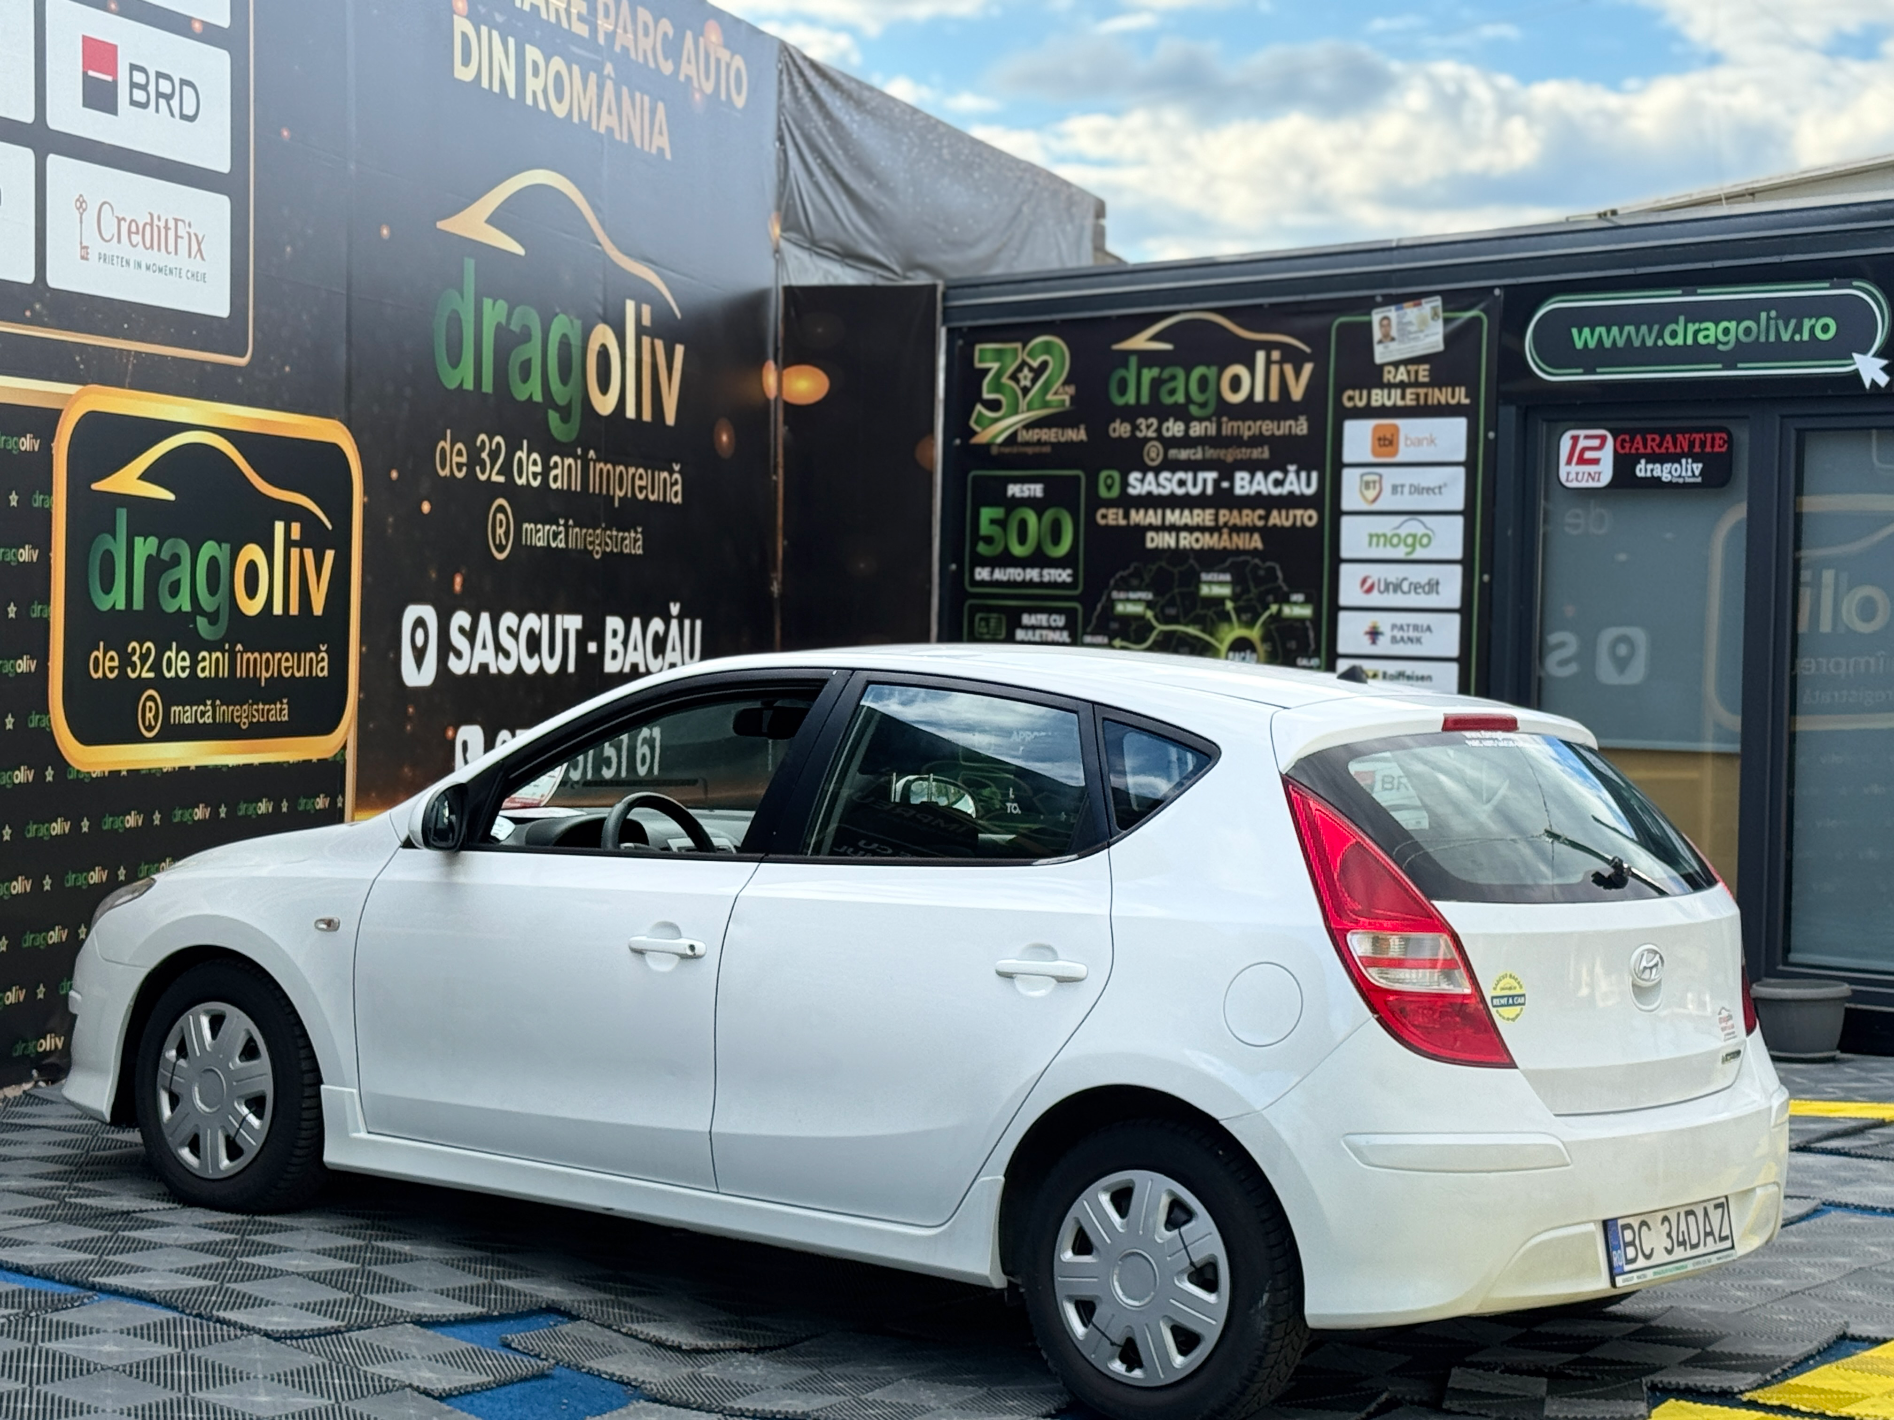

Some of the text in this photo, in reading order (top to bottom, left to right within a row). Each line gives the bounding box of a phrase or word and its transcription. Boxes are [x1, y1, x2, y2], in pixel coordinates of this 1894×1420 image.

[597, 0, 674, 76] PARC
[678, 29, 748, 110] AUTO
[128, 62, 201, 124] BRD
[454, 14, 672, 161] DIN ROMÂNIA
[96, 200, 206, 262] CreditFix
[98, 252, 207, 284] PRIETEN IN MOMENTE CHEIE
[1571, 309, 1838, 352] www.dragoliv.ro
[433, 256, 685, 443] dragoliv
[969, 334, 1070, 433] 32
[1108, 350, 1315, 417] dragoliv
[1382, 364, 1431, 384] RATE
[1342, 386, 1471, 408] CU BULETINUL
[1108, 415, 1308, 441] de 32 de ani împreună
[1377, 433, 1438, 448] tbi bank
[1565, 434, 1608, 466] 12
[1615, 432, 1728, 454] GARANTIE
[435, 429, 683, 508] de 32 de ani împreună
[1126, 470, 1219, 496] SASCUT
[1233, 463, 1318, 496] BACĂU
[1565, 471, 1603, 483] LUNI
[1635, 458, 1703, 482] dragoliv
[1007, 483, 1044, 498] PESTE
[1391, 484, 1406, 496] BT
[1095, 508, 1318, 527] CEL MAI MARE PARC AUTO
[522, 518, 566, 549] marcă
[568, 519, 643, 560] înregistrată
[976, 506, 1074, 558] 500
[1145, 528, 1263, 550] DIN ROMÂNIA
[1367, 532, 1432, 557] mogo
[88, 507, 336, 641] dragoliv
[974, 567, 1073, 583] DE AUTO PE STOC
[1377, 576, 1440, 596] UniCredit
[1021, 613, 1066, 627] RATE CU
[1390, 623, 1433, 634] PATRIA
[447, 610, 583, 676] SASCUT
[604, 602, 702, 673] BACĂU
[1015, 628, 1071, 643] BULETINUL
[1390, 635, 1423, 646] BANK
[88, 641, 329, 688] de 32 de ani împreună
[1381, 669, 1433, 683] Raiffeisen
[170, 699, 213, 726] marcă
[215, 697, 289, 730] înregistrată
[636, 726, 661, 777] 61
[172, 803, 211, 824] dragoliv
[237, 798, 273, 818] dragoliv
[297, 793, 330, 814] dragoliv
[25, 816, 71, 840] dragoliv
[102, 810, 144, 832] dragoliv
[64, 866, 109, 889] dragoliv
[22, 925, 68, 949] dragoliv
[12, 1032, 65, 1057] dragoliv
[1620, 1219, 1655, 1266] BC
[1612, 1250, 1624, 1268] RO
